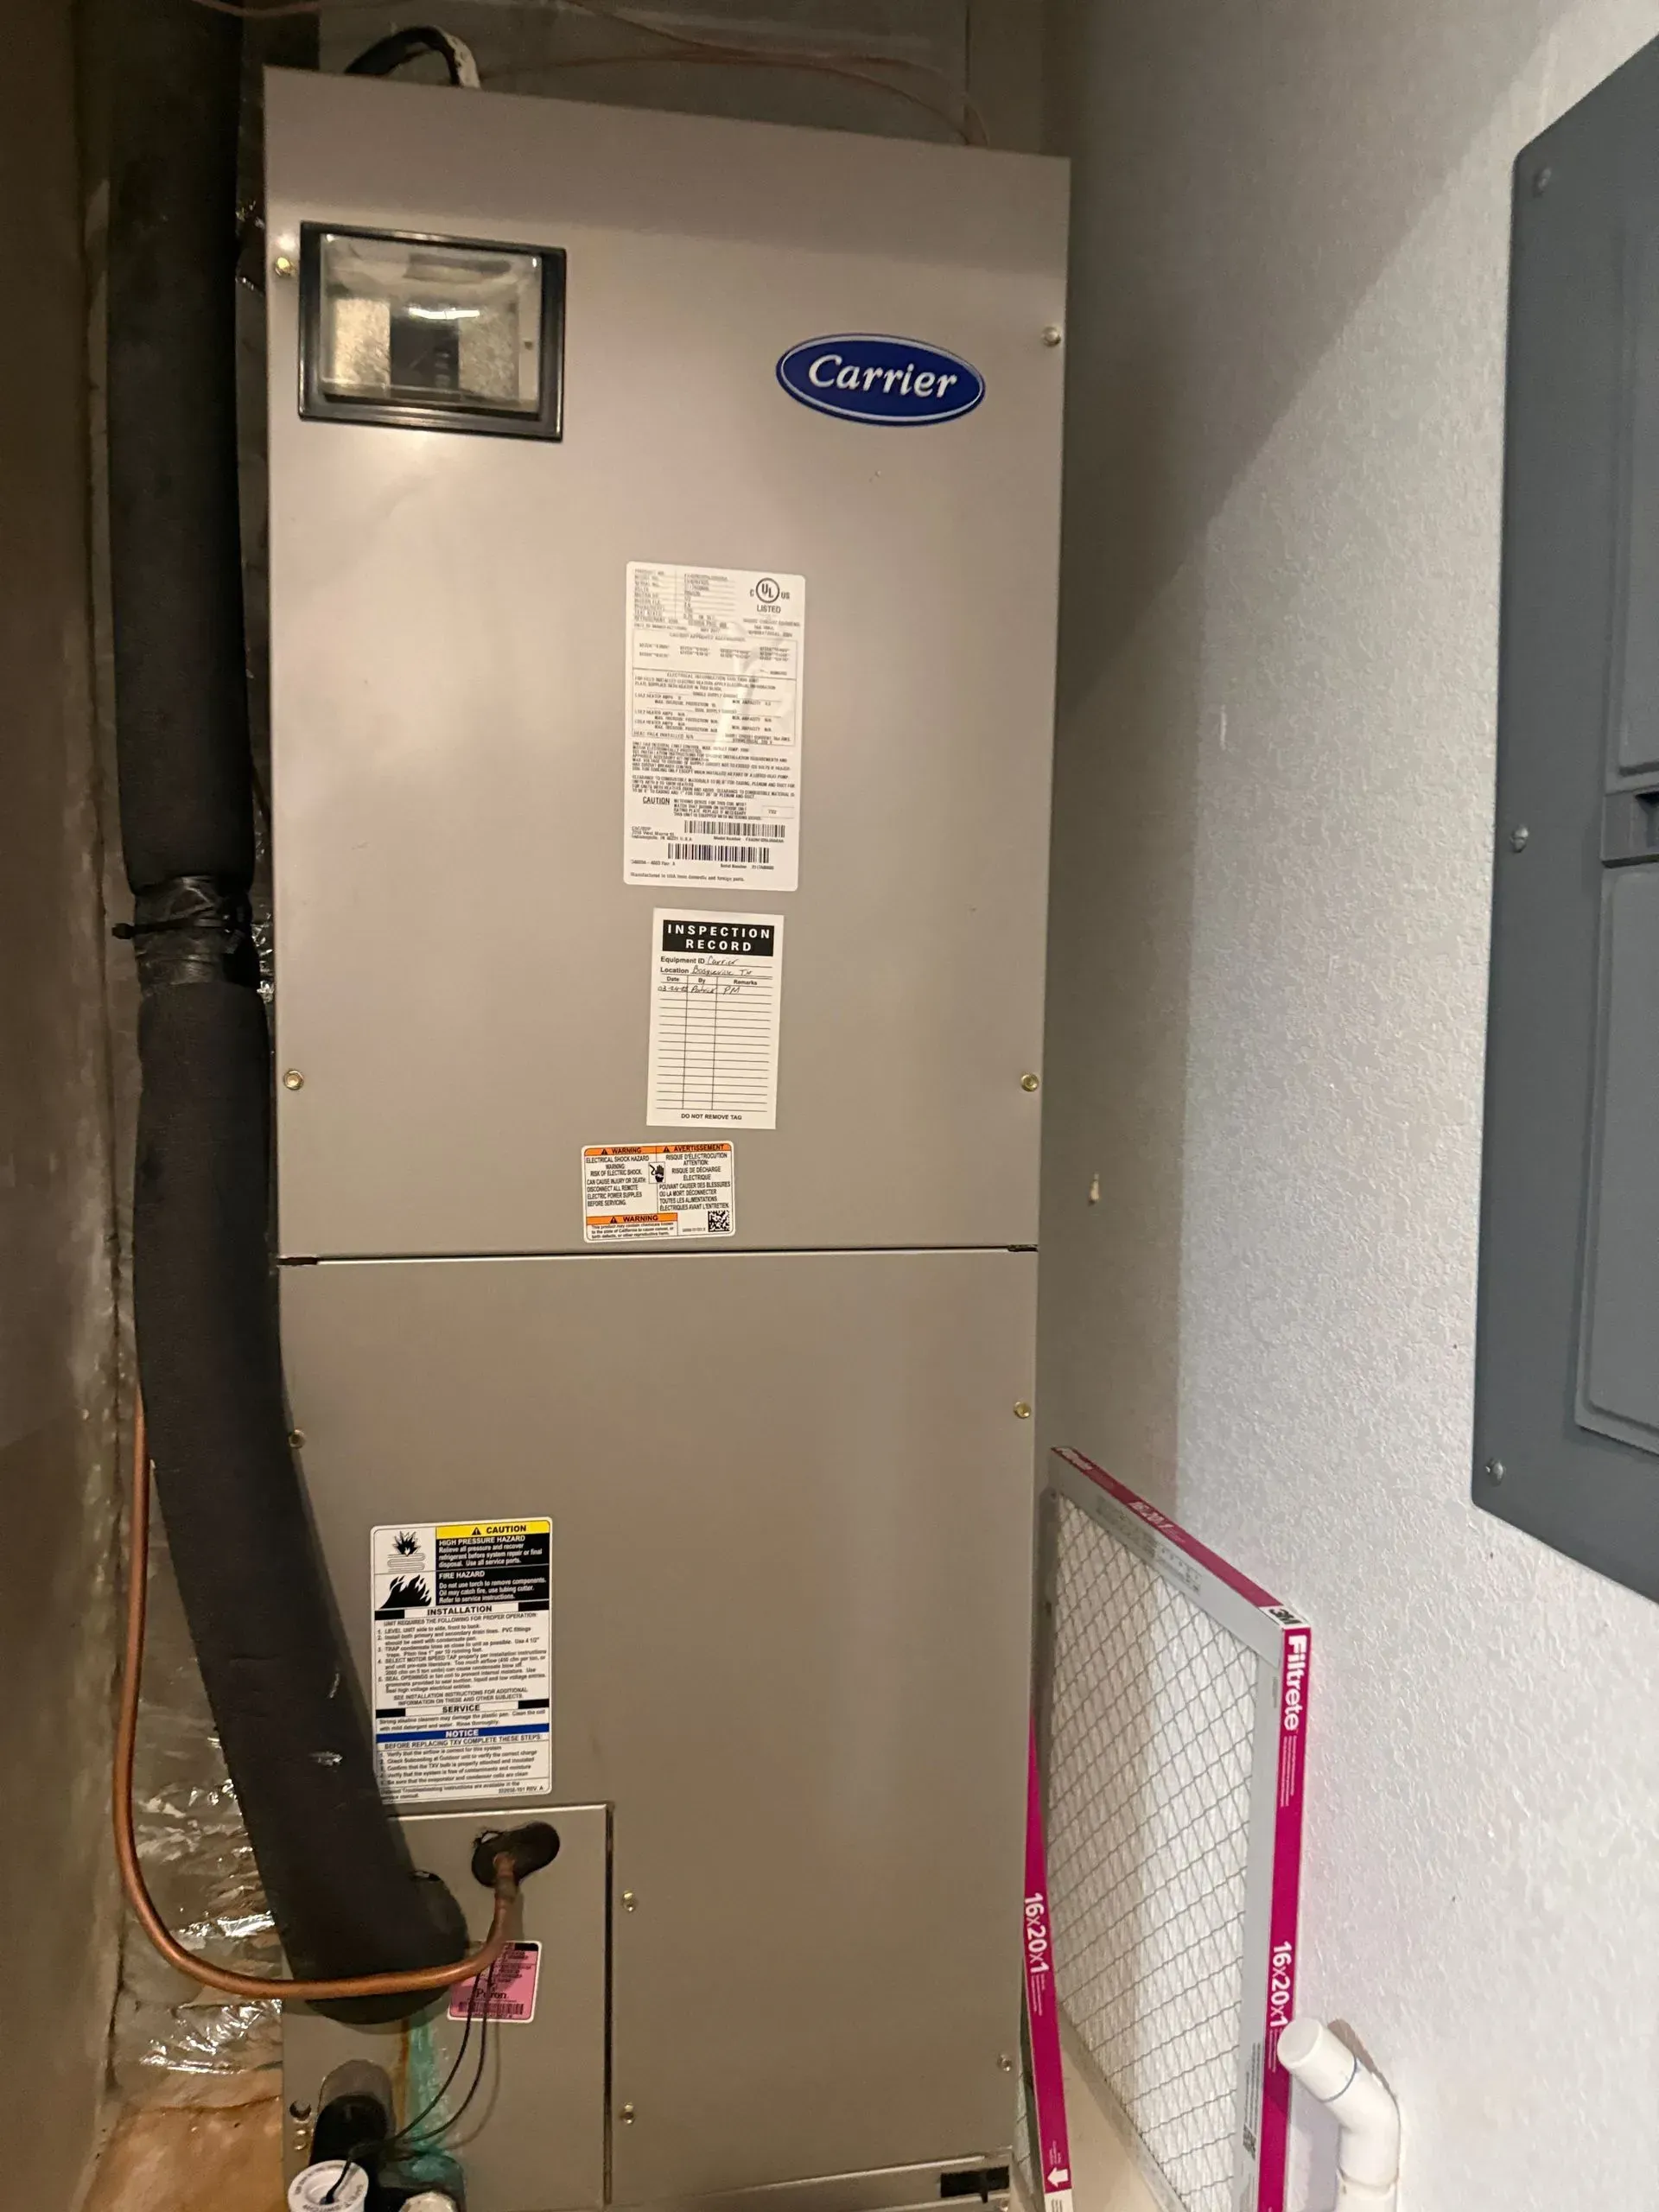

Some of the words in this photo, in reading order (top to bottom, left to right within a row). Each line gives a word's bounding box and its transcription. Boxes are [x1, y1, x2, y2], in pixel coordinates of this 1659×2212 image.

[809, 354, 957, 397] Carrier
[762, 583, 773, 598] UL
[756, 604, 781, 614] LISTED
[642, 796, 670, 805] CAUTION
[667, 925, 770, 938] INSPECTION
[686, 939, 752, 951] RECORD
[661, 956, 696, 965] Equipment
[486, 1525, 526, 1534] CAUTION
[458, 1537, 495, 1545] PRESSURE
[468, 1545, 491, 1553] pressure
[427, 1605, 492, 1616] INSTALLATION
[1269, 1608, 1303, 1625] 3M
[1284, 1635, 1307, 1731] Filtrete
[442, 1705, 481, 1713] SERVICE
[445, 1729, 479, 1738] NOTICE
[1025, 1892, 1049, 1974] 16x20x1
[1269, 1941, 1293, 2027] 16x20x1
